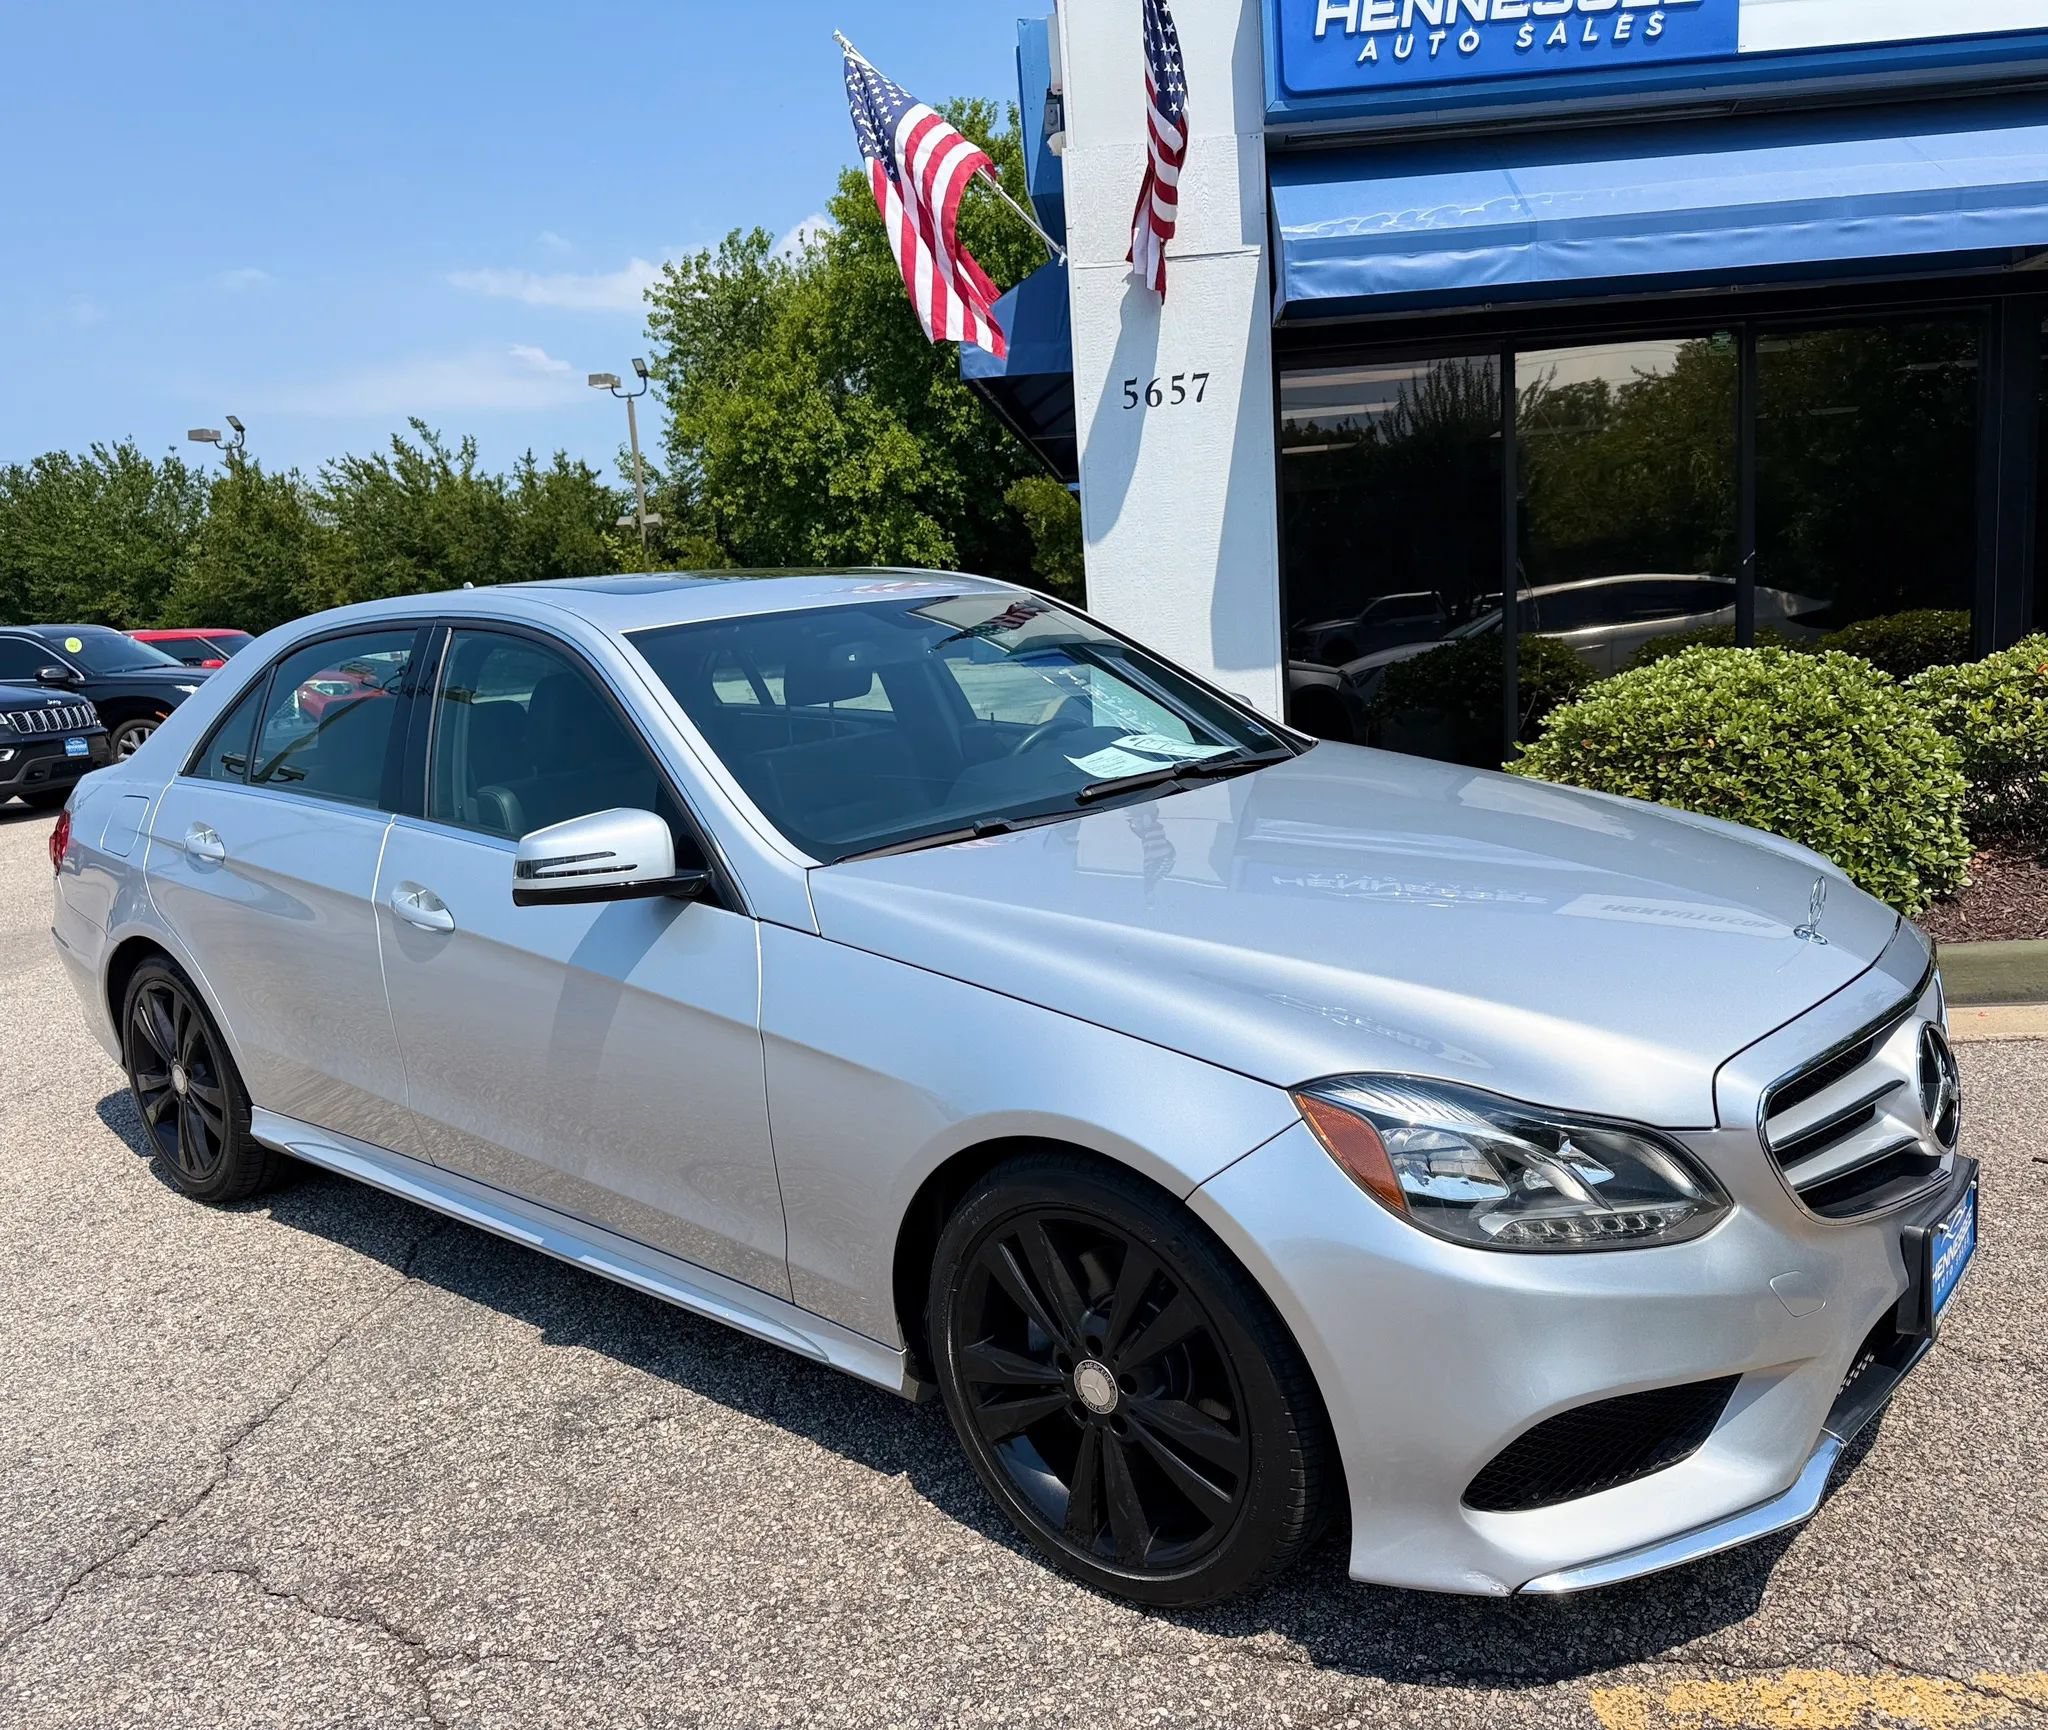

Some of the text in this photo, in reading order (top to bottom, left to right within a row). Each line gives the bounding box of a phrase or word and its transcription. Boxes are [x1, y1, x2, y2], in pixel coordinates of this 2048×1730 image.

[1357, 11, 1665, 62] AUTO SALES
[1123, 372, 1209, 409] 5657
